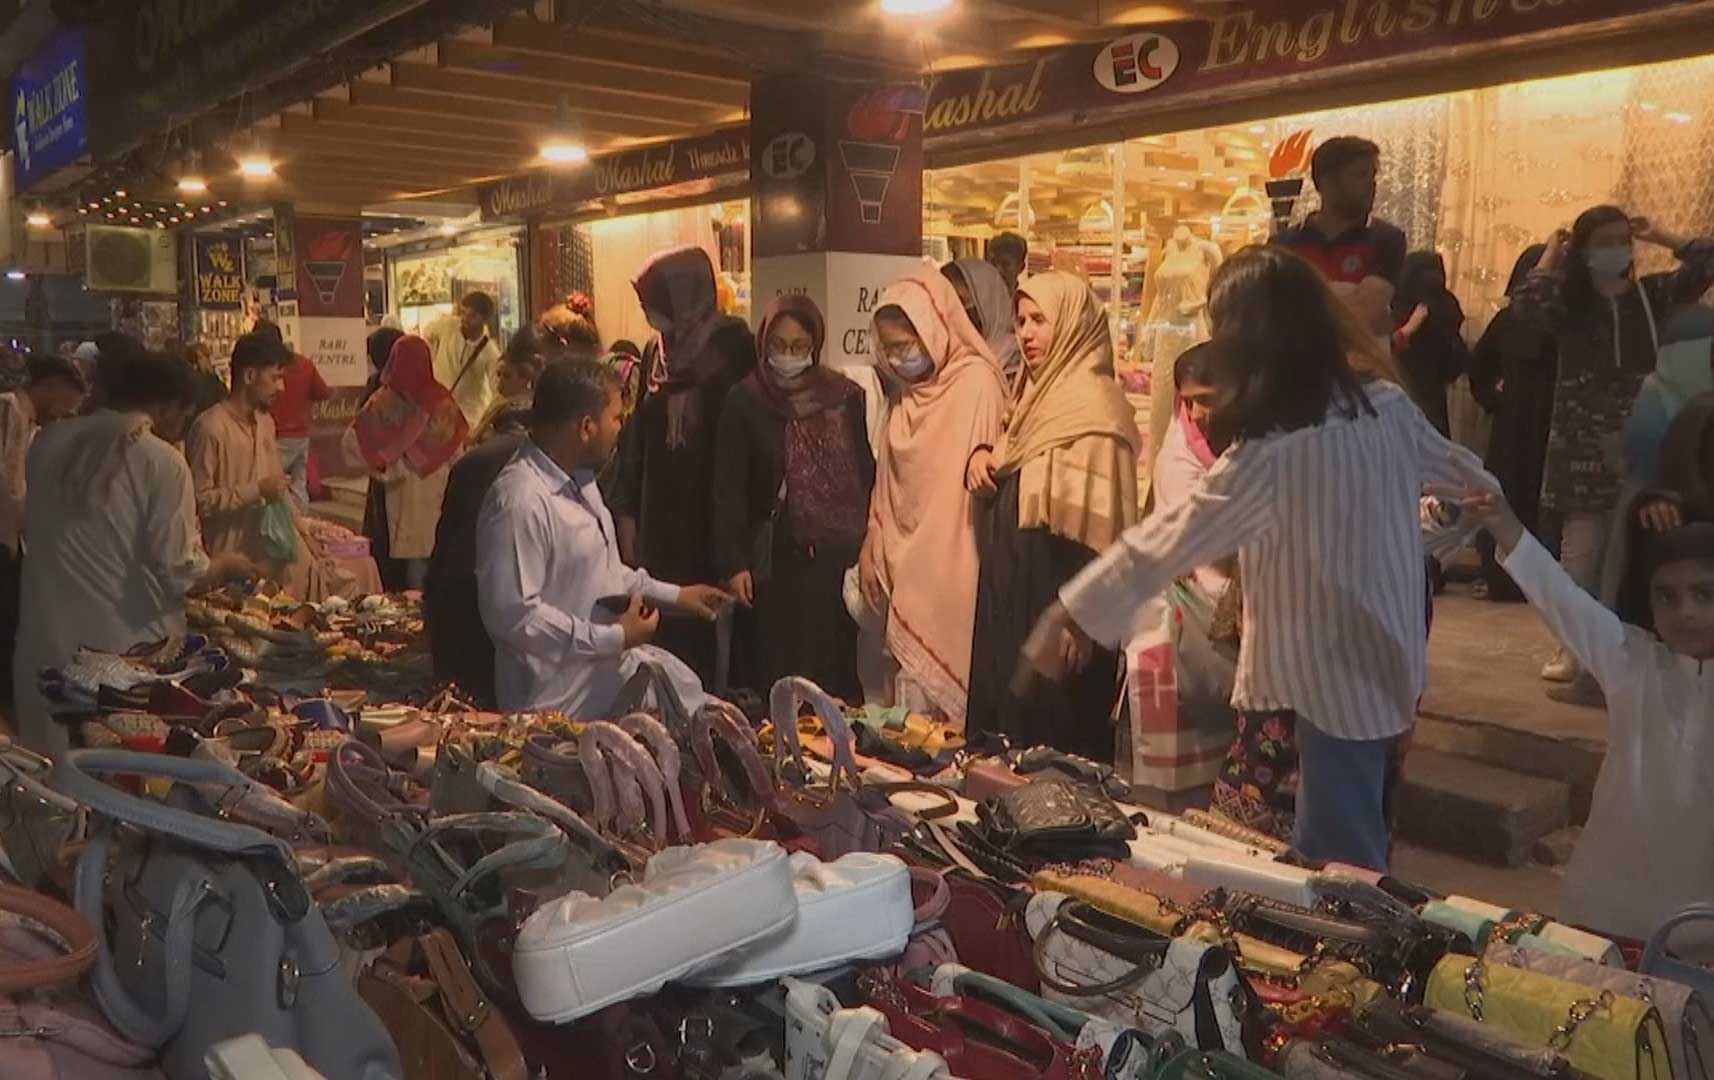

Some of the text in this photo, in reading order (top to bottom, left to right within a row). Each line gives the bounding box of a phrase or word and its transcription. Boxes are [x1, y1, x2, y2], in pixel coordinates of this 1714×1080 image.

[1110, 37, 1162, 87] EC
[594, 144, 676, 192] Mashal
[199, 273, 242, 288] WALK
[201, 288, 241, 303] ZONE
[857, 287, 886, 313] RA
[319, 339, 347, 351] RABI
[311, 354, 357, 365] CENTRE
